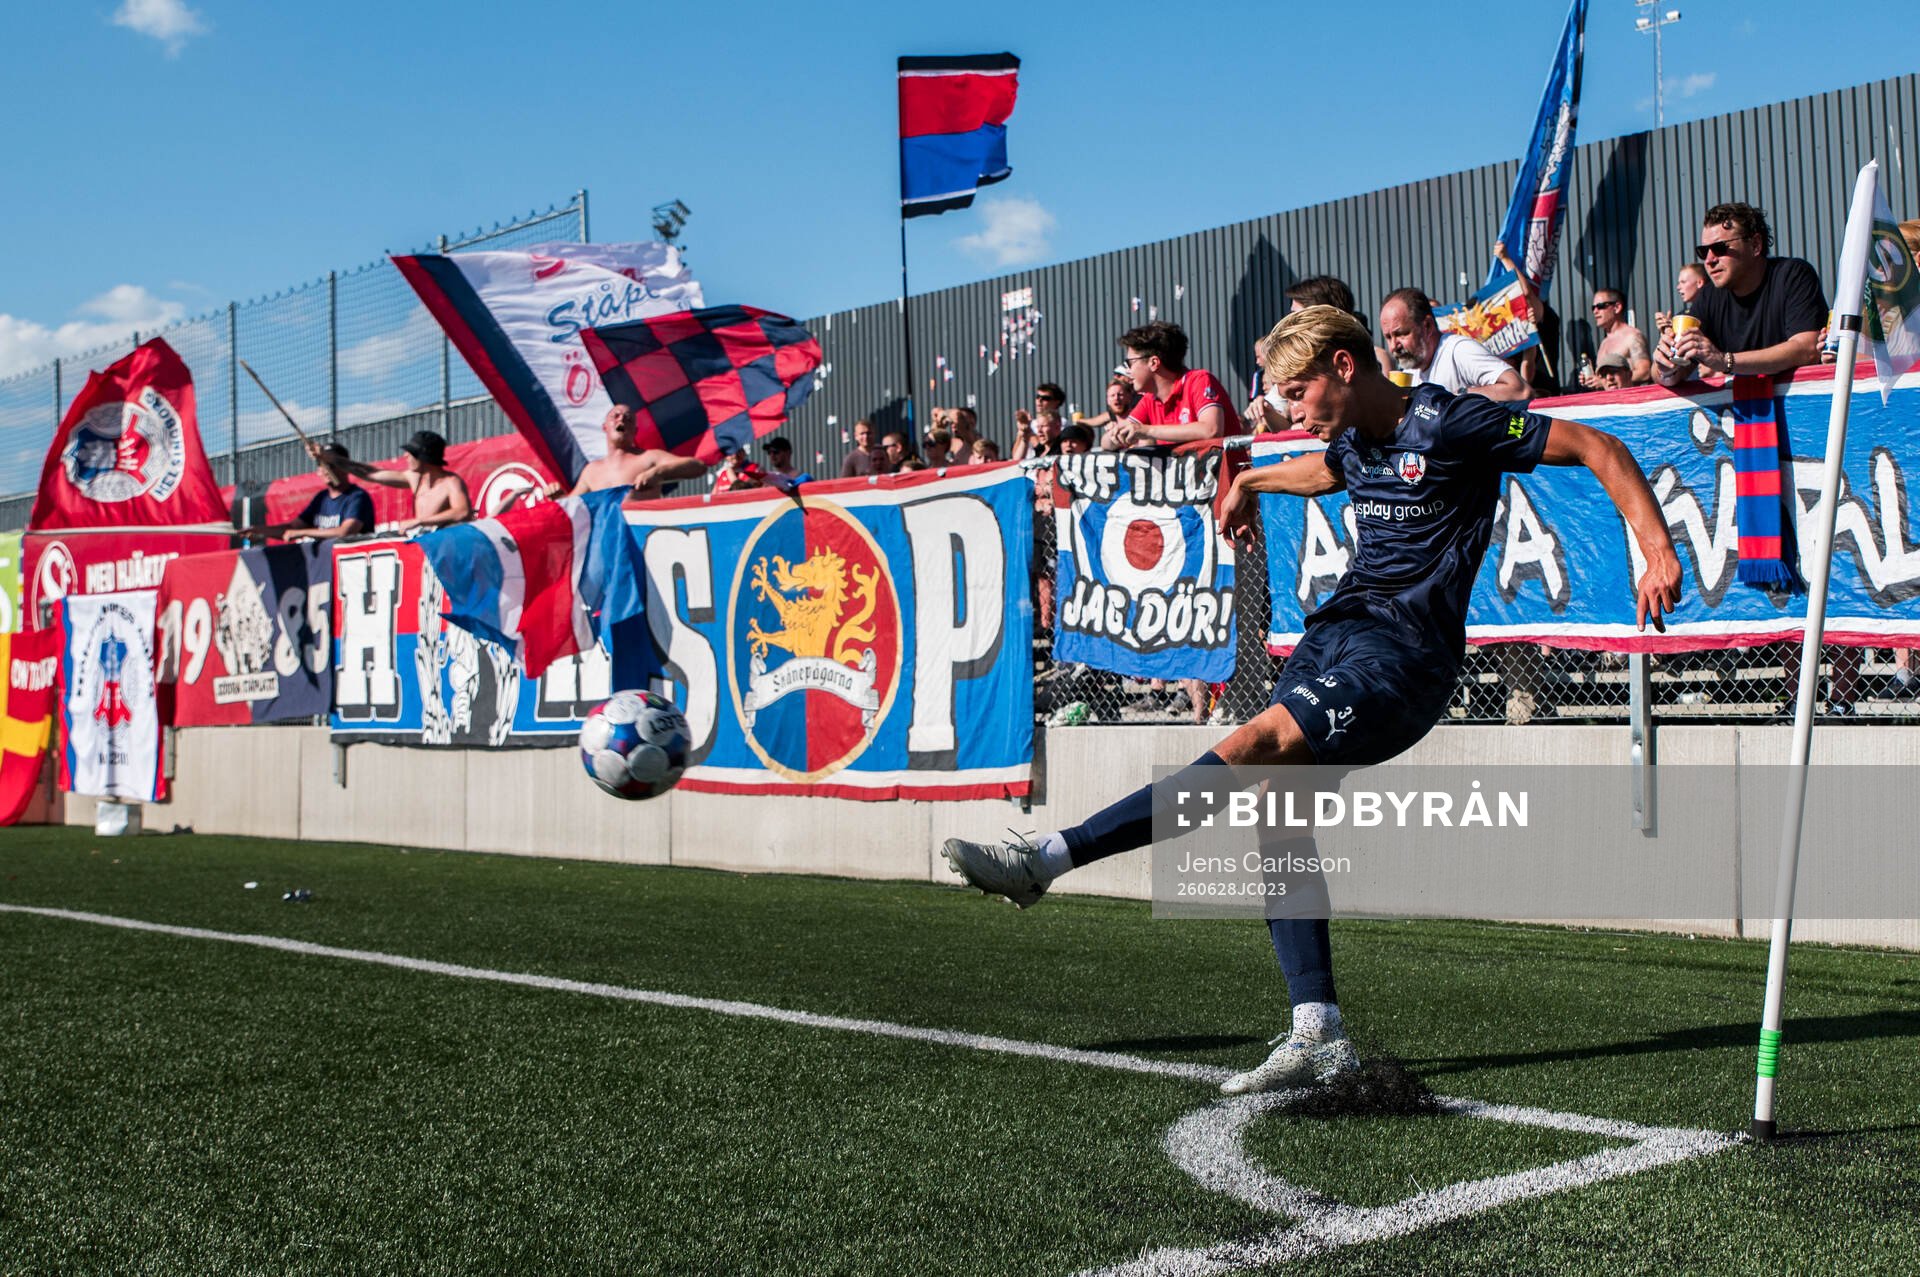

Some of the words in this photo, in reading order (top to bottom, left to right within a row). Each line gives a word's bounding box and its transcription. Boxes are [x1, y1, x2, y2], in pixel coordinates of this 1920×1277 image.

[1394, 500, 1445, 522] group
[86, 561, 116, 595] MED
[1062, 580, 1125, 635] JAG
[1135, 582, 1233, 646] DÖR!
